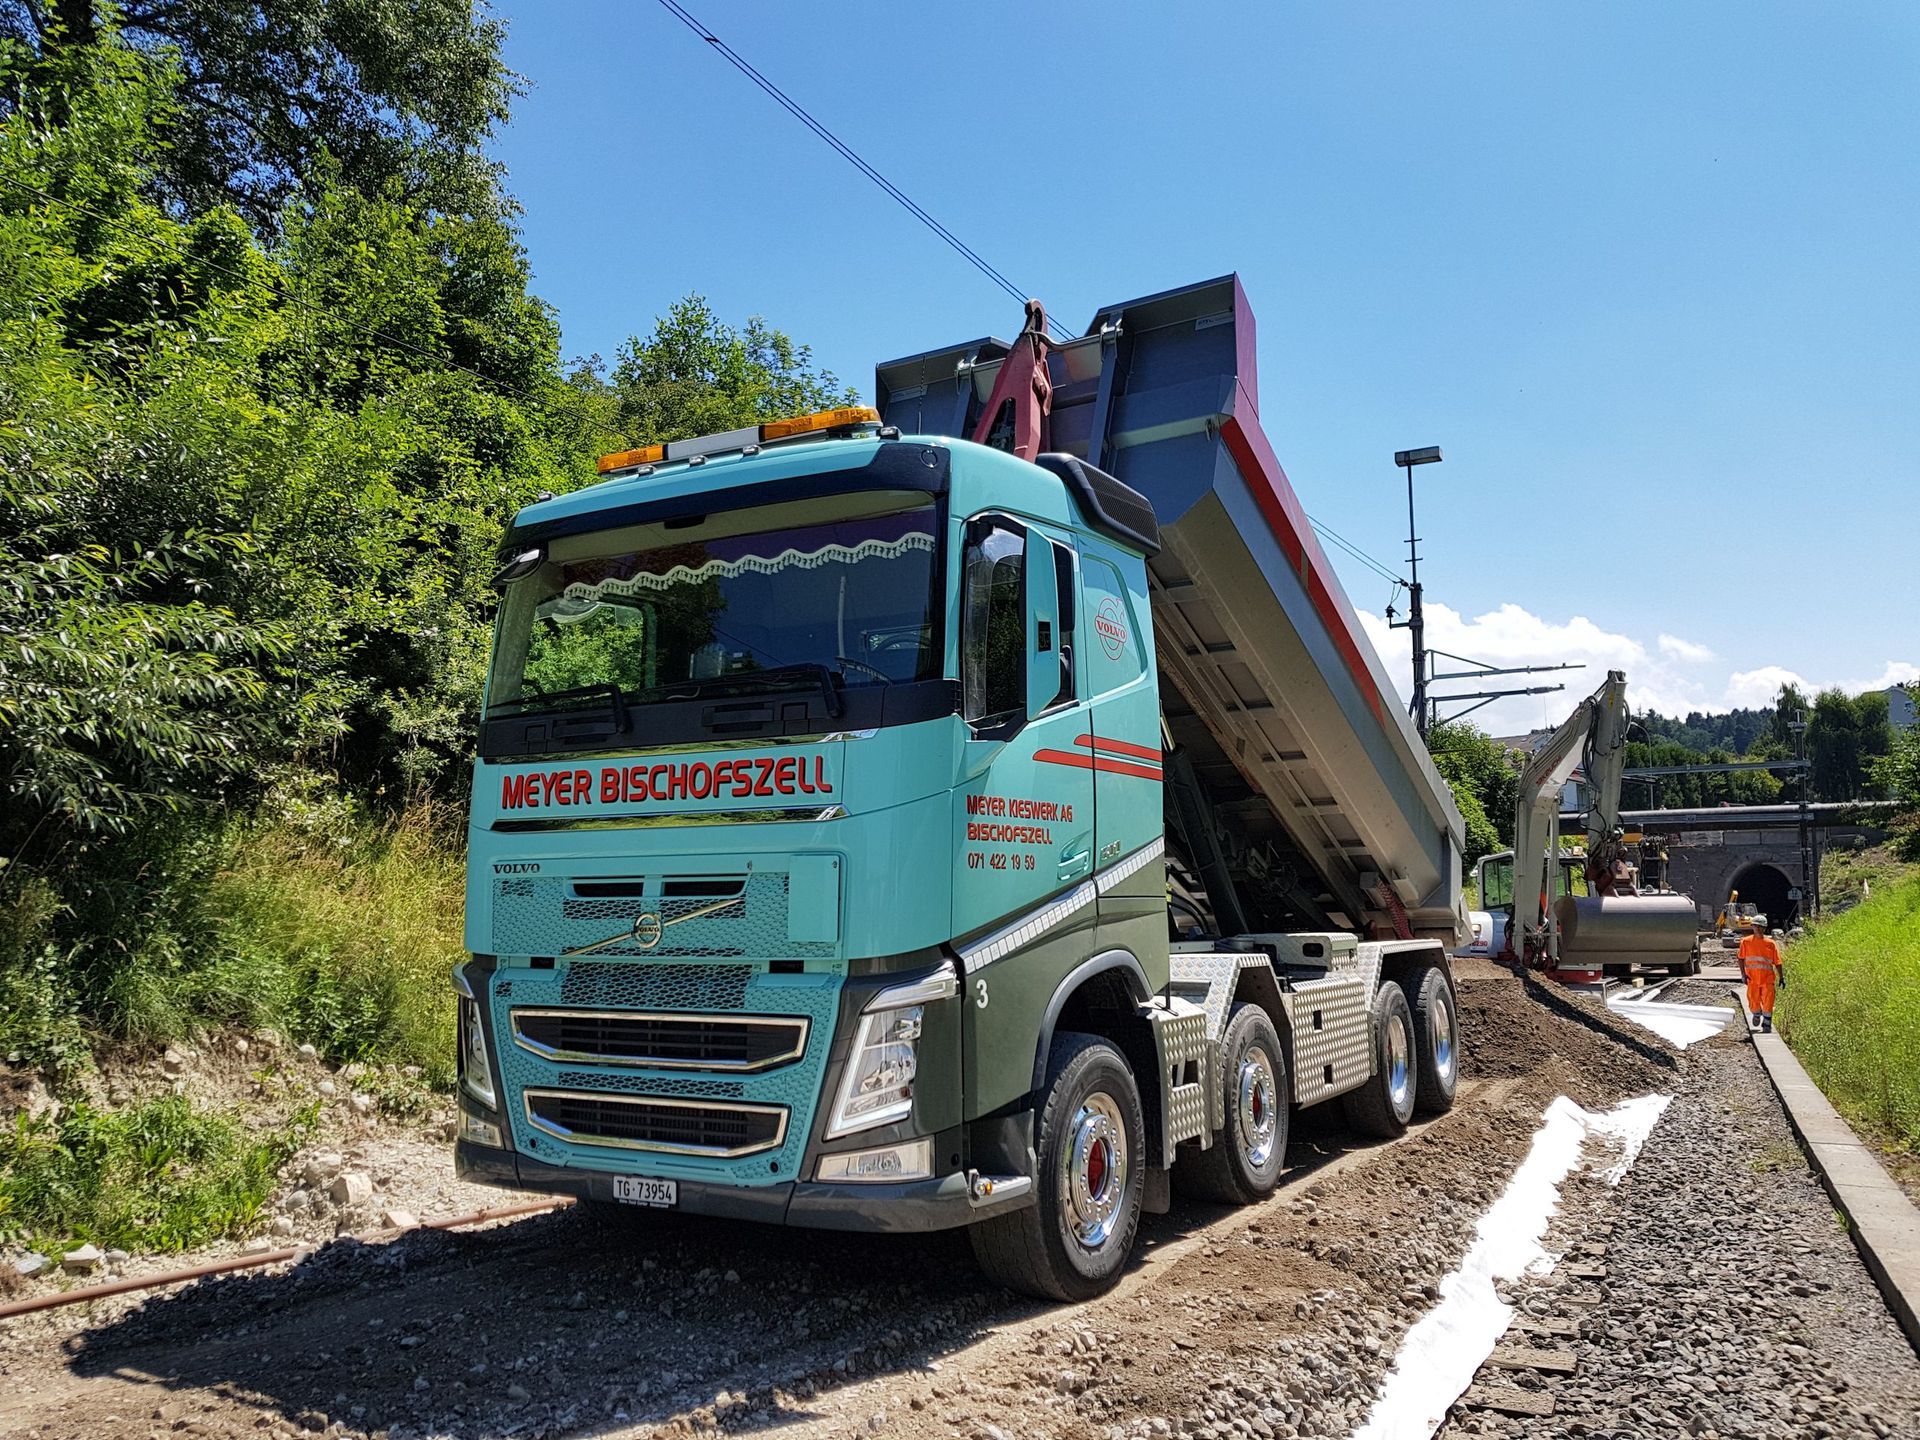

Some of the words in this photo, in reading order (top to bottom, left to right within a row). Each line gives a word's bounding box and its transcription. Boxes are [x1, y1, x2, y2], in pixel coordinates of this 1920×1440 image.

[1096, 620, 1126, 640] VOLVO
[502, 769, 592, 809] MEYER
[600, 755, 833, 803] BISCHOFSZELL
[966, 794, 1006, 817] MEYER
[1009, 798, 1059, 822] KIESWERK
[1060, 804, 1073, 823] AG
[967, 822, 1053, 845] BISCHOFSZELL
[492, 863, 541, 875] VOLVO
[968, 852, 985, 869] 071
[989, 853, 1007, 870] 422
[1011, 854, 1021, 871] 19
[1024, 855, 1036, 871] 59
[976, 978, 989, 1009] 3
